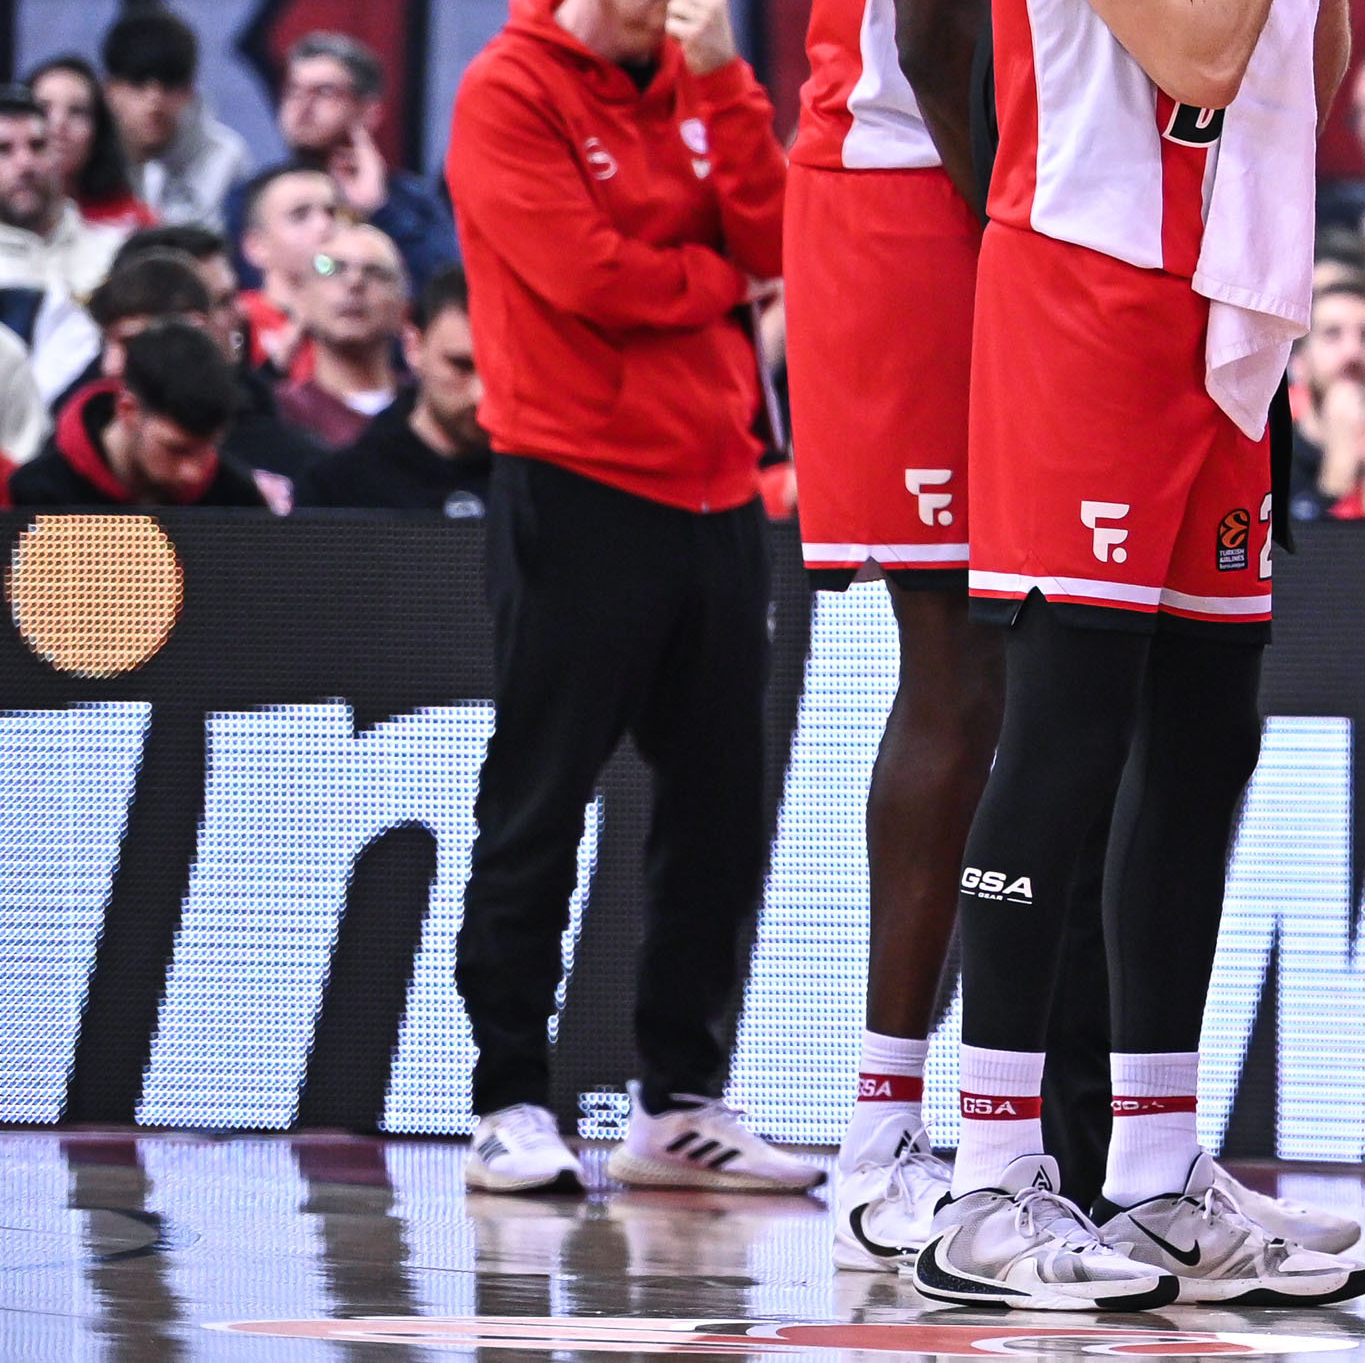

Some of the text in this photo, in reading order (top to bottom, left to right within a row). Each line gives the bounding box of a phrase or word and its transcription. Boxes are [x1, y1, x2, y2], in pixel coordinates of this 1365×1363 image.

[962, 867, 1033, 899] GSA
[978, 892, 1004, 901] GEAR
[963, 1098, 1016, 1116] GSA
